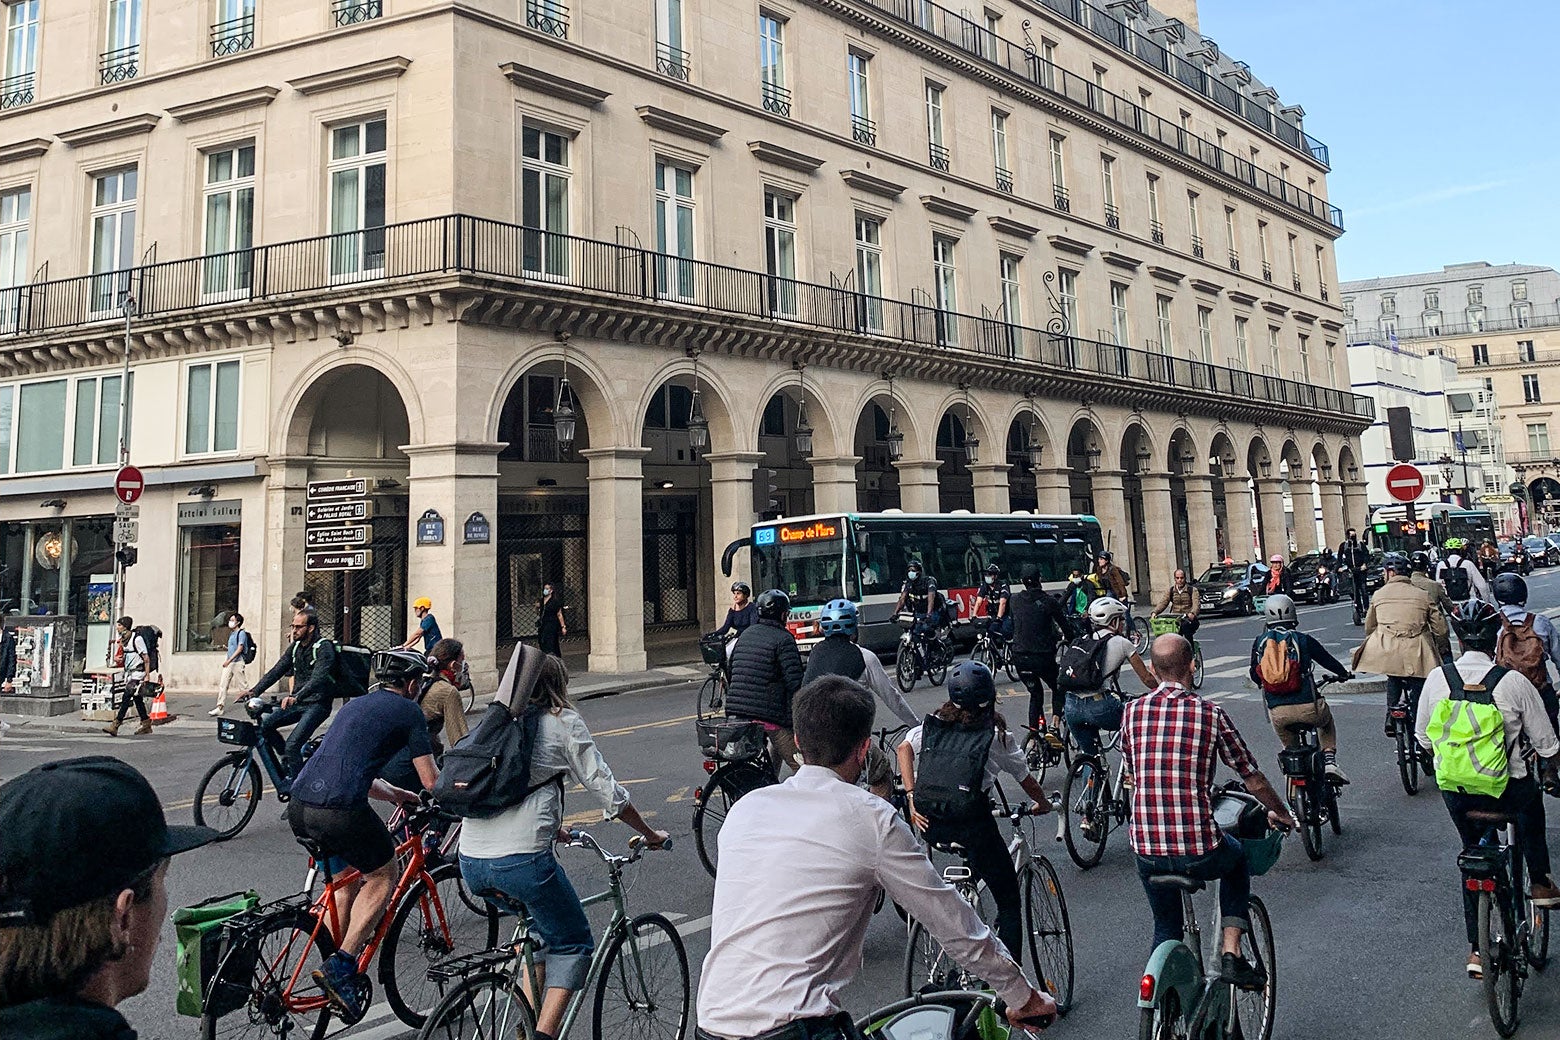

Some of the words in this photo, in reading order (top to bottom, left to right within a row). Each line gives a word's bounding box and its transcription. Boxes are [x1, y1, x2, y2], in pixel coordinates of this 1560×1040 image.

[759, 531, 771, 542] 69
[781, 527, 805, 541] Champ
[805, 527, 815, 538] de
[815, 523, 835, 537] Mars
